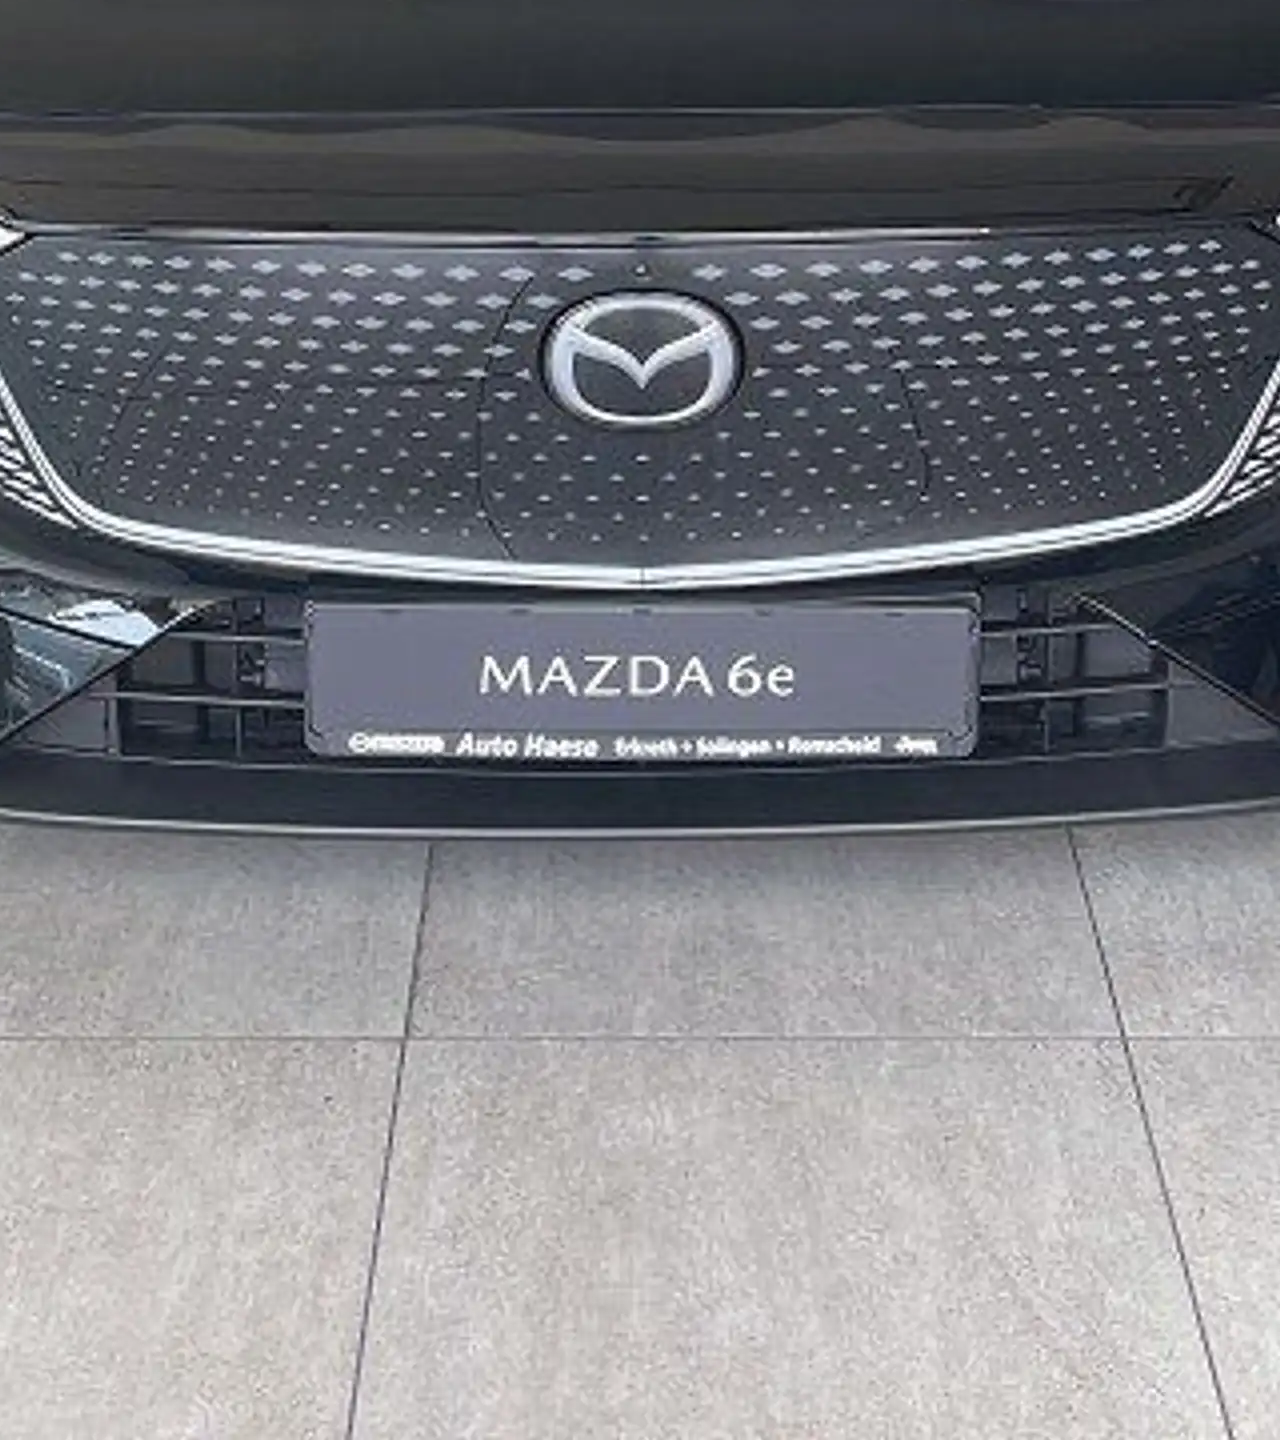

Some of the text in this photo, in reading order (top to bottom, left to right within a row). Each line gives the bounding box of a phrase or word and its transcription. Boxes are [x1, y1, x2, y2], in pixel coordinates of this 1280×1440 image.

[479, 653, 795, 697] MAZDA 6e
[456, 732, 518, 757] Auto
